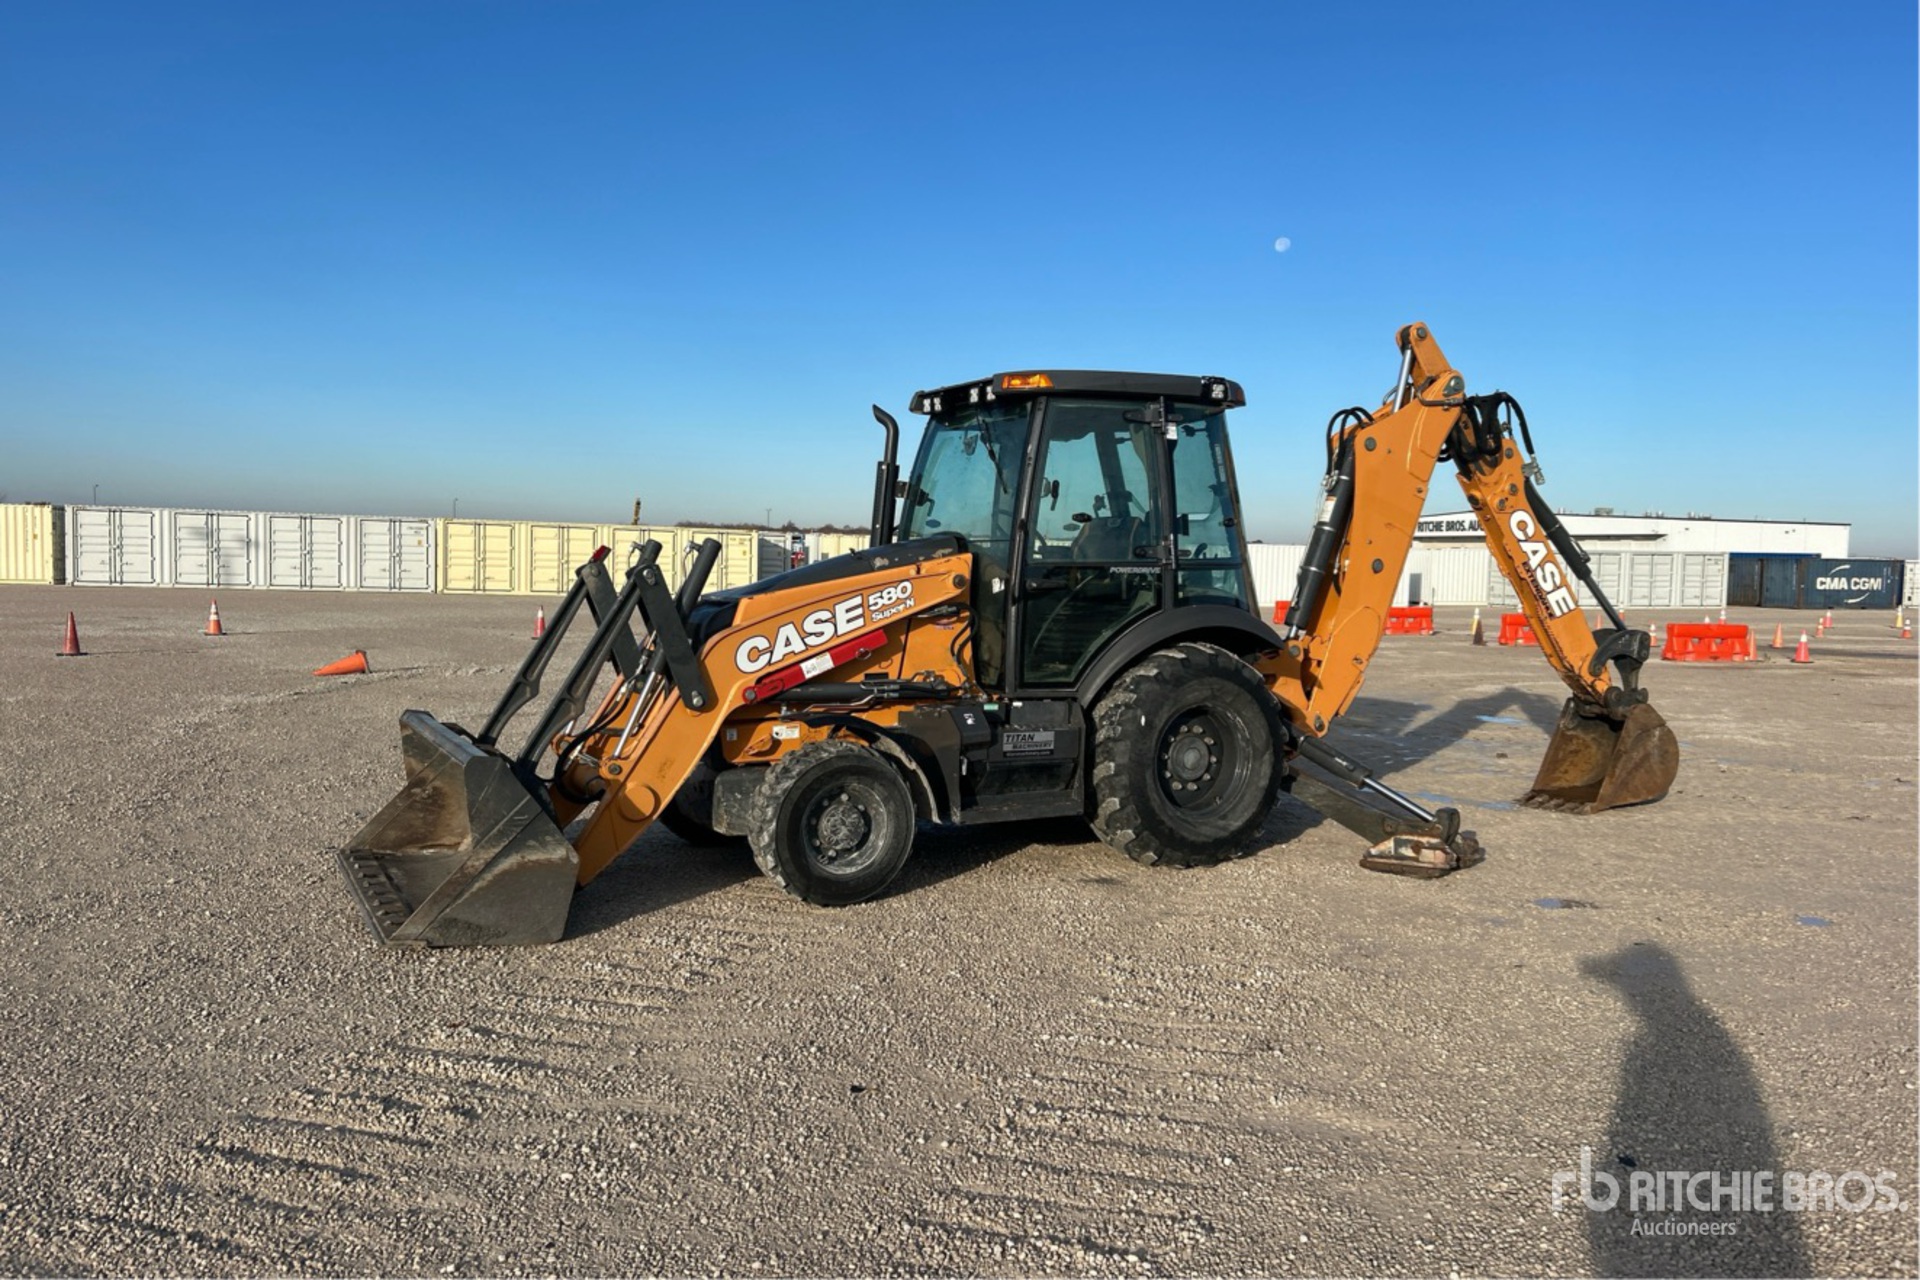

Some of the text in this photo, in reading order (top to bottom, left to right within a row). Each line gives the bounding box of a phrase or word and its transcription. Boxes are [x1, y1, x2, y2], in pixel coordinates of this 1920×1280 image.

[1417, 520, 1445, 532] RITCHIE
[1509, 509, 1577, 618] CASE
[1816, 577, 1848, 591] CMA
[1850, 577, 1882, 591] CGM
[868, 580, 913, 611] 580
[735, 594, 866, 674] CASE
[1005, 733, 1036, 743] TITAN
